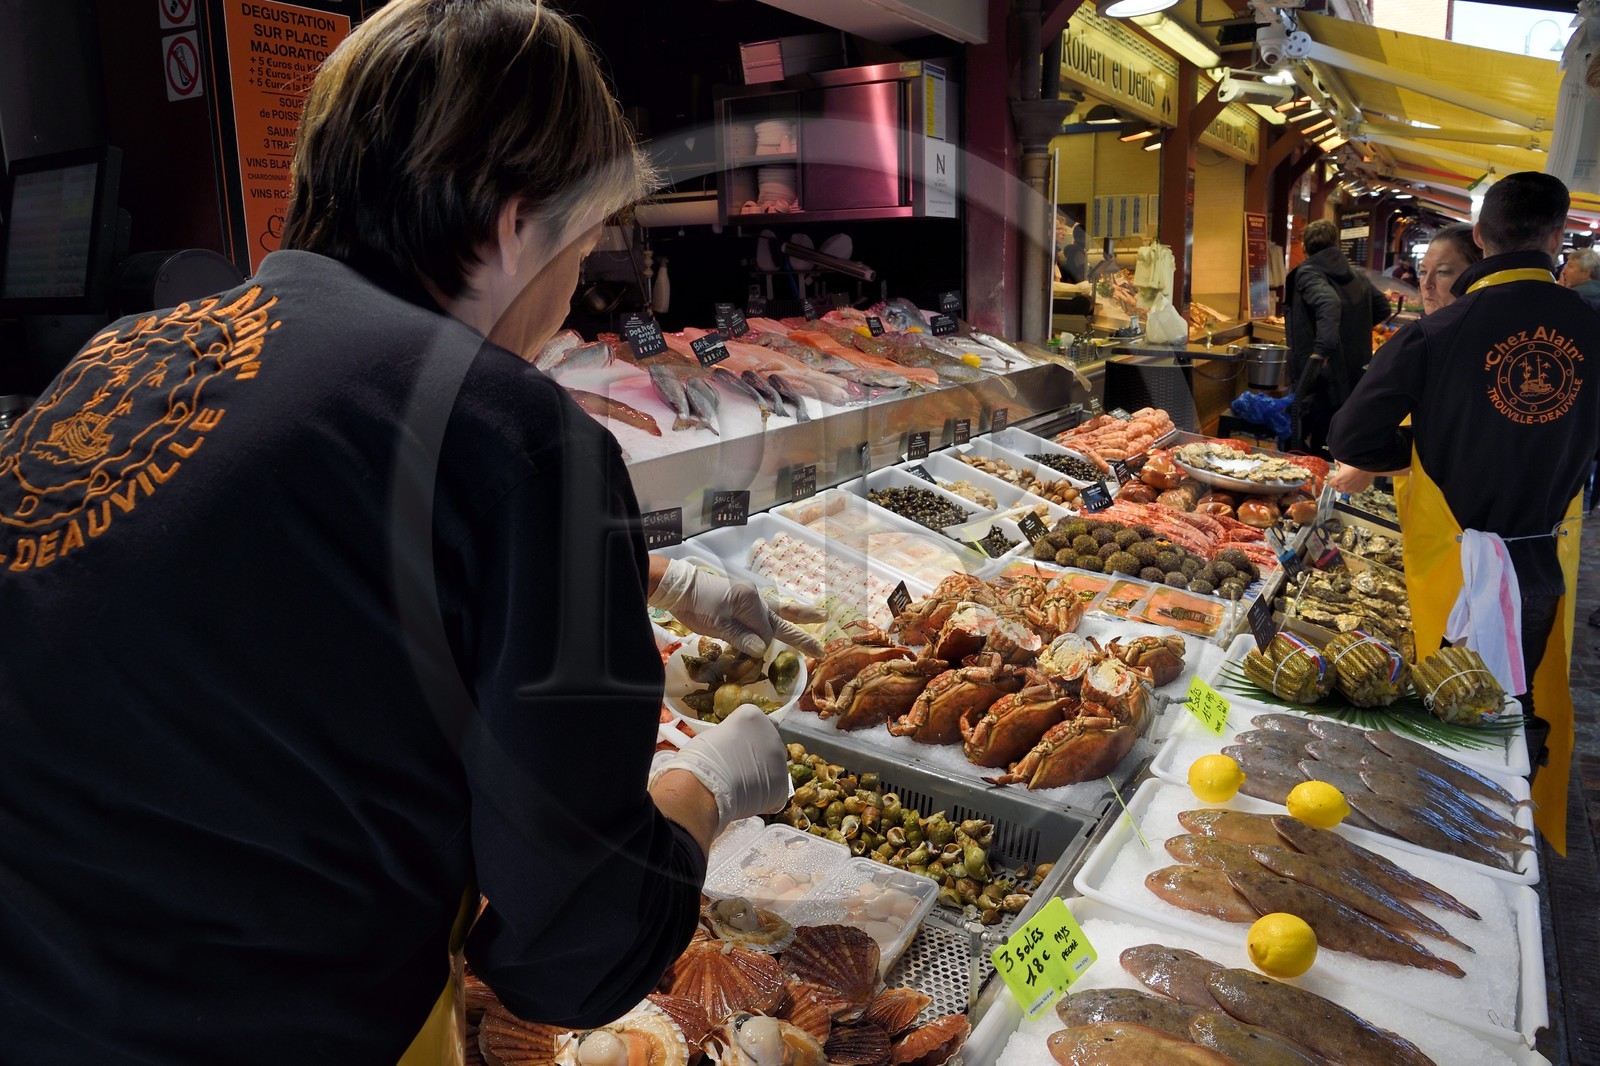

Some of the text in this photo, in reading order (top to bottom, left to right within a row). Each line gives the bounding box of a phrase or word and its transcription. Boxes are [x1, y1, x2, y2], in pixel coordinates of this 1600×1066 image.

[241, 3, 336, 32] DEGUSTATION
[253, 23, 329, 48] SUR PLACE
[259, 56, 264, 65] 5
[294, 62, 306, 71] du
[1062, 29, 1155, 107] Robert et Denis
[257, 66, 263, 76] 5
[256, 77, 263, 87] 5
[279, 97, 304, 108] SOUP
[260, 108, 302, 121] de POISS
[263, 138, 270, 149] 3
[246, 157, 268, 169] VINS
[247, 173, 287, 181] CHARDONNAY
[250, 188, 272, 199] VINS
[693, 340, 710, 352] BAR
[1487, 378, 1584, 424] TROUVILLE-DEAUVILLE
[643, 510, 678, 527] EURRE
[999, 927, 1045, 973] 3 SOLES
